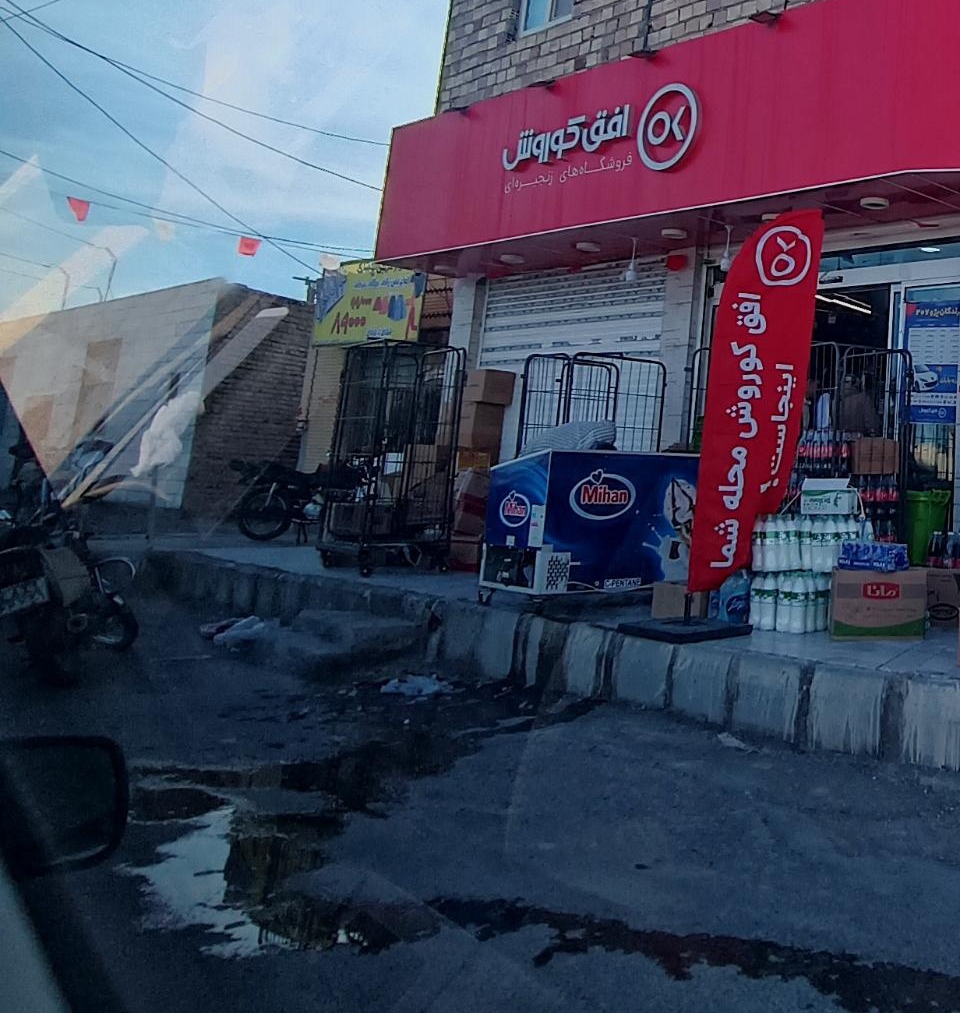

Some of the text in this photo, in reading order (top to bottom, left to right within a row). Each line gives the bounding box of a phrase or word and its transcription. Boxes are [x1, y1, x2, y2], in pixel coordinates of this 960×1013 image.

[502, 103, 632, 172] افق کوروش
[647, 105, 686, 146] OK
[731, 292, 767, 335] افق
[725, 341, 764, 439] کوروش
[580, 485, 629, 505] Mihan
[718, 446, 748, 510] محله
[709, 518, 740, 568] شما
